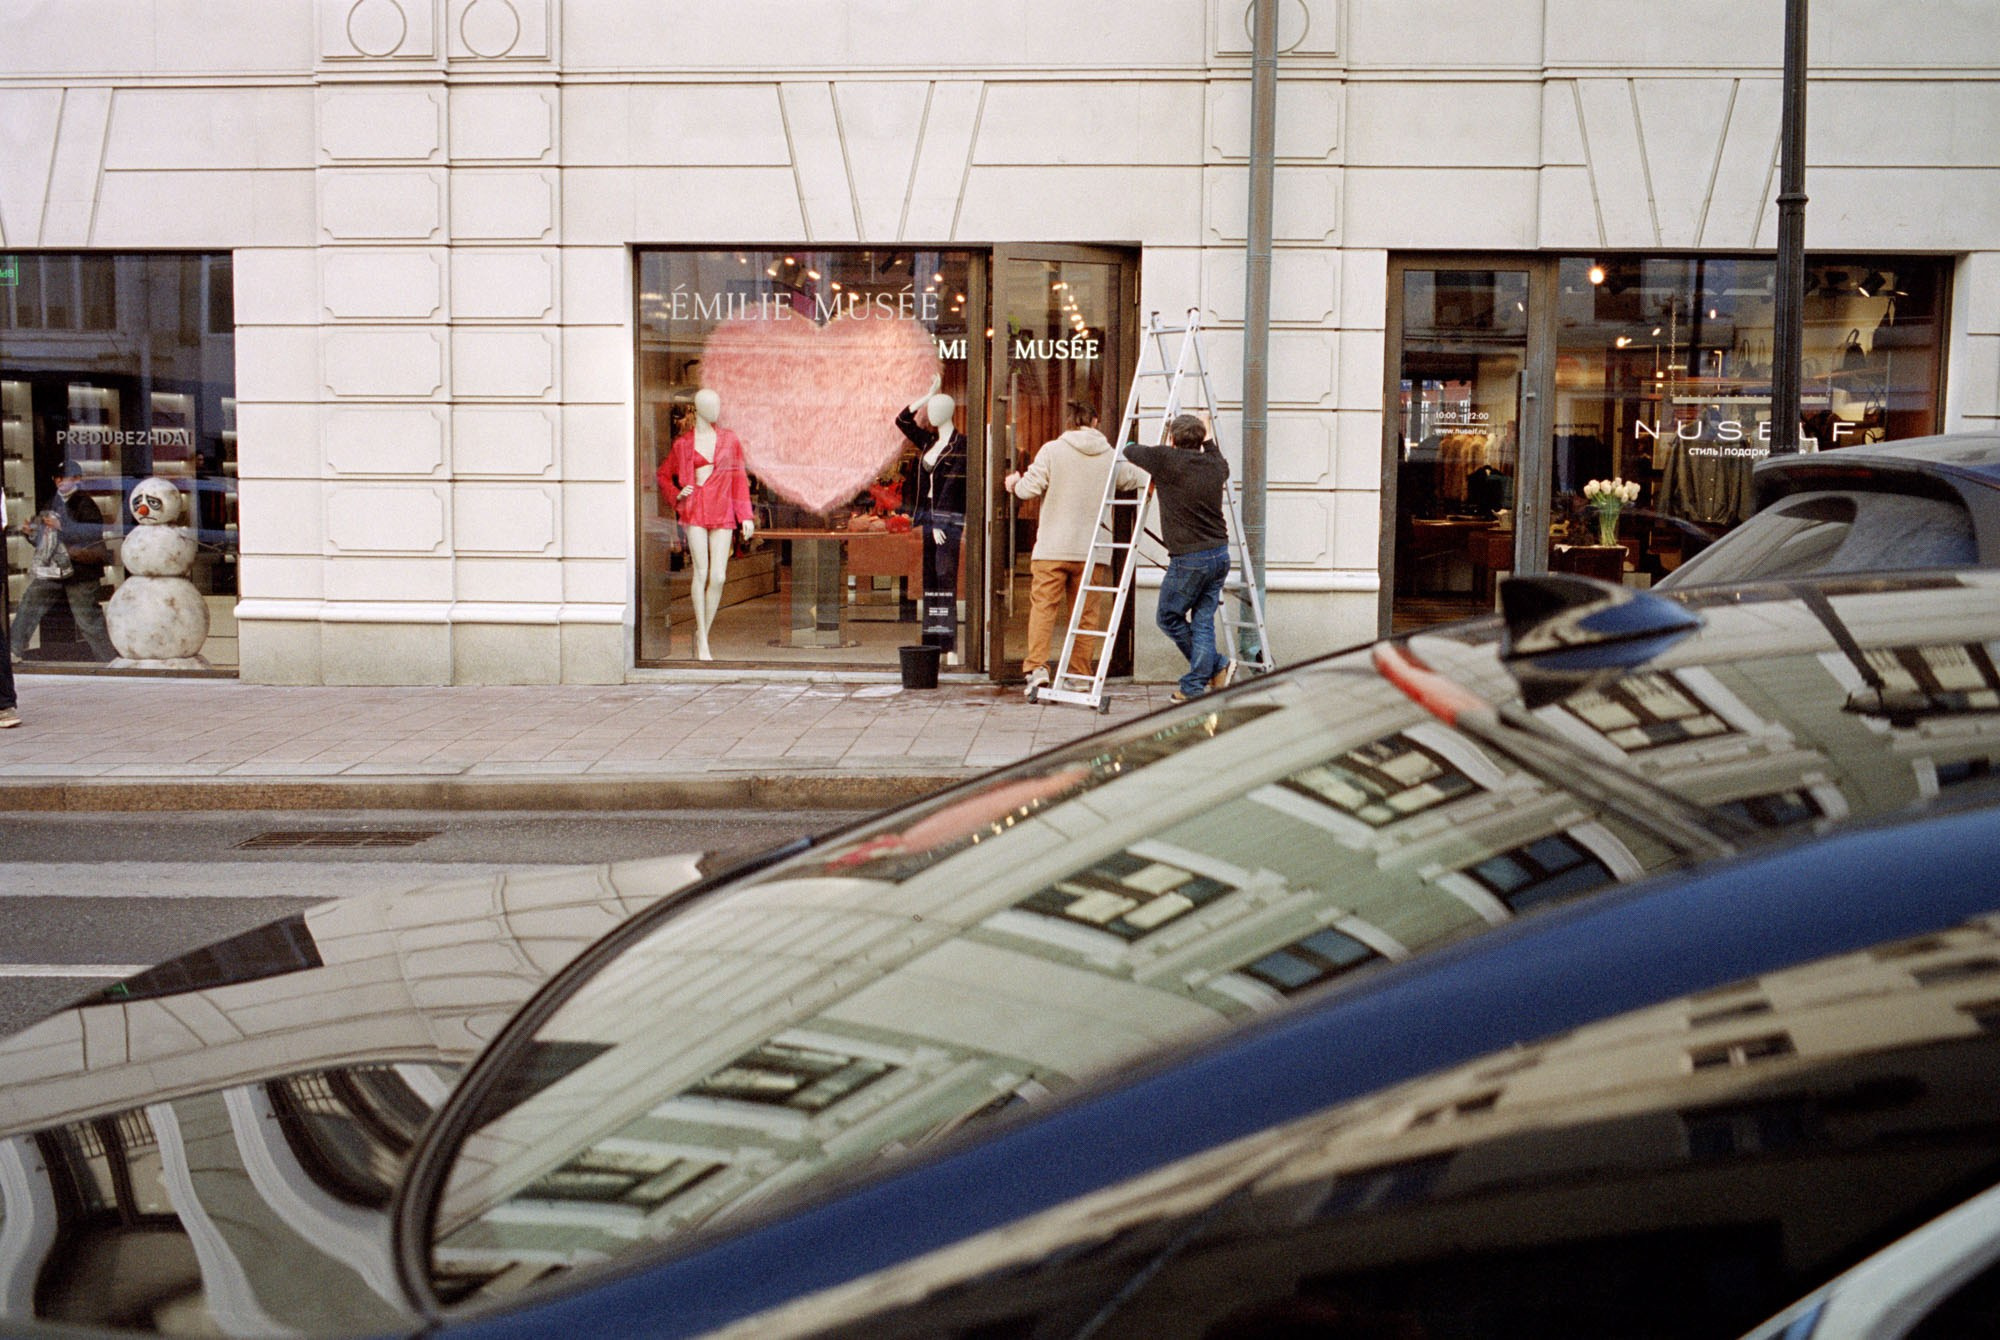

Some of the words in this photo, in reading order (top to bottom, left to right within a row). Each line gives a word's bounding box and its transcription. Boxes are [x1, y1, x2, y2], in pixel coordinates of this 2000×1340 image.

[671, 284, 791, 321] ÉMILIE
[814, 284, 939, 321] MUSÉE
[1015, 334, 1099, 359] MUSÉE
